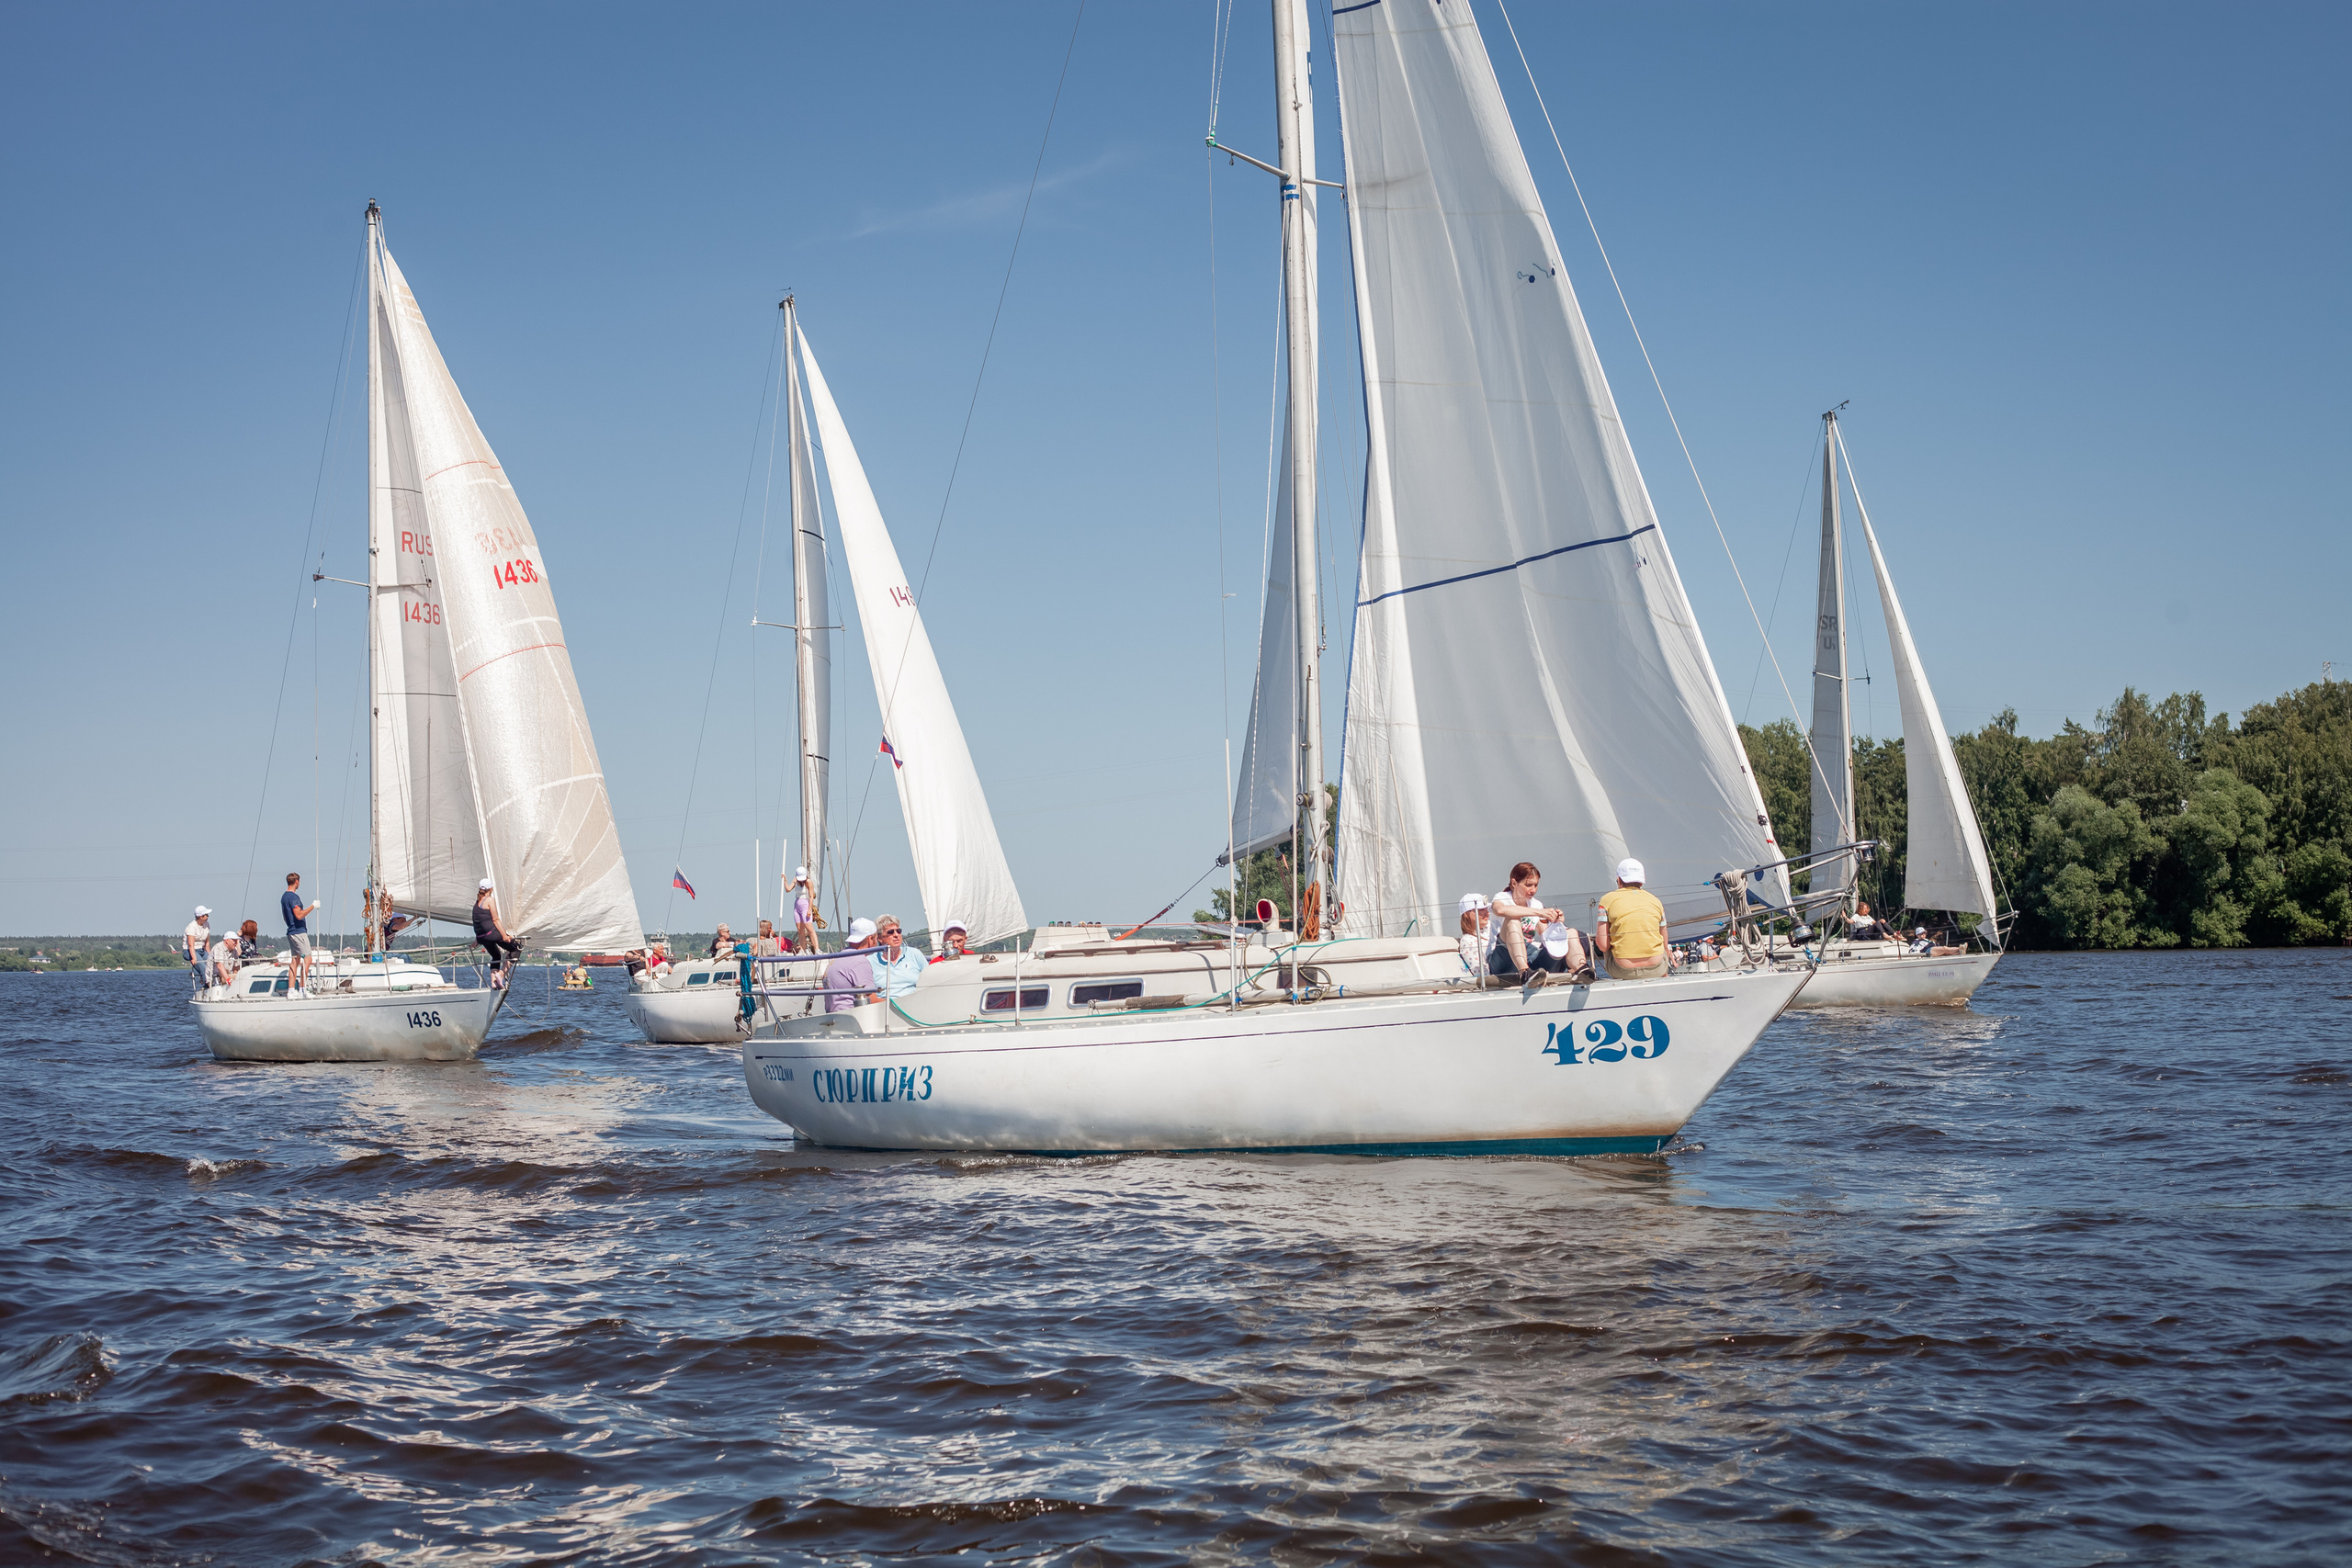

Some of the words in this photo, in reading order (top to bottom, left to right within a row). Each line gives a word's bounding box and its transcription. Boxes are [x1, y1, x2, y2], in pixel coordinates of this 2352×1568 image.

[401, 531, 433, 557] RUS
[493, 558, 538, 590] 1436
[404, 601, 441, 626] 1436
[407, 1010, 442, 1029] 1436
[1542, 1015, 1670, 1066] 429
[813, 1066, 933, 1103] СЮРПРИЗ
